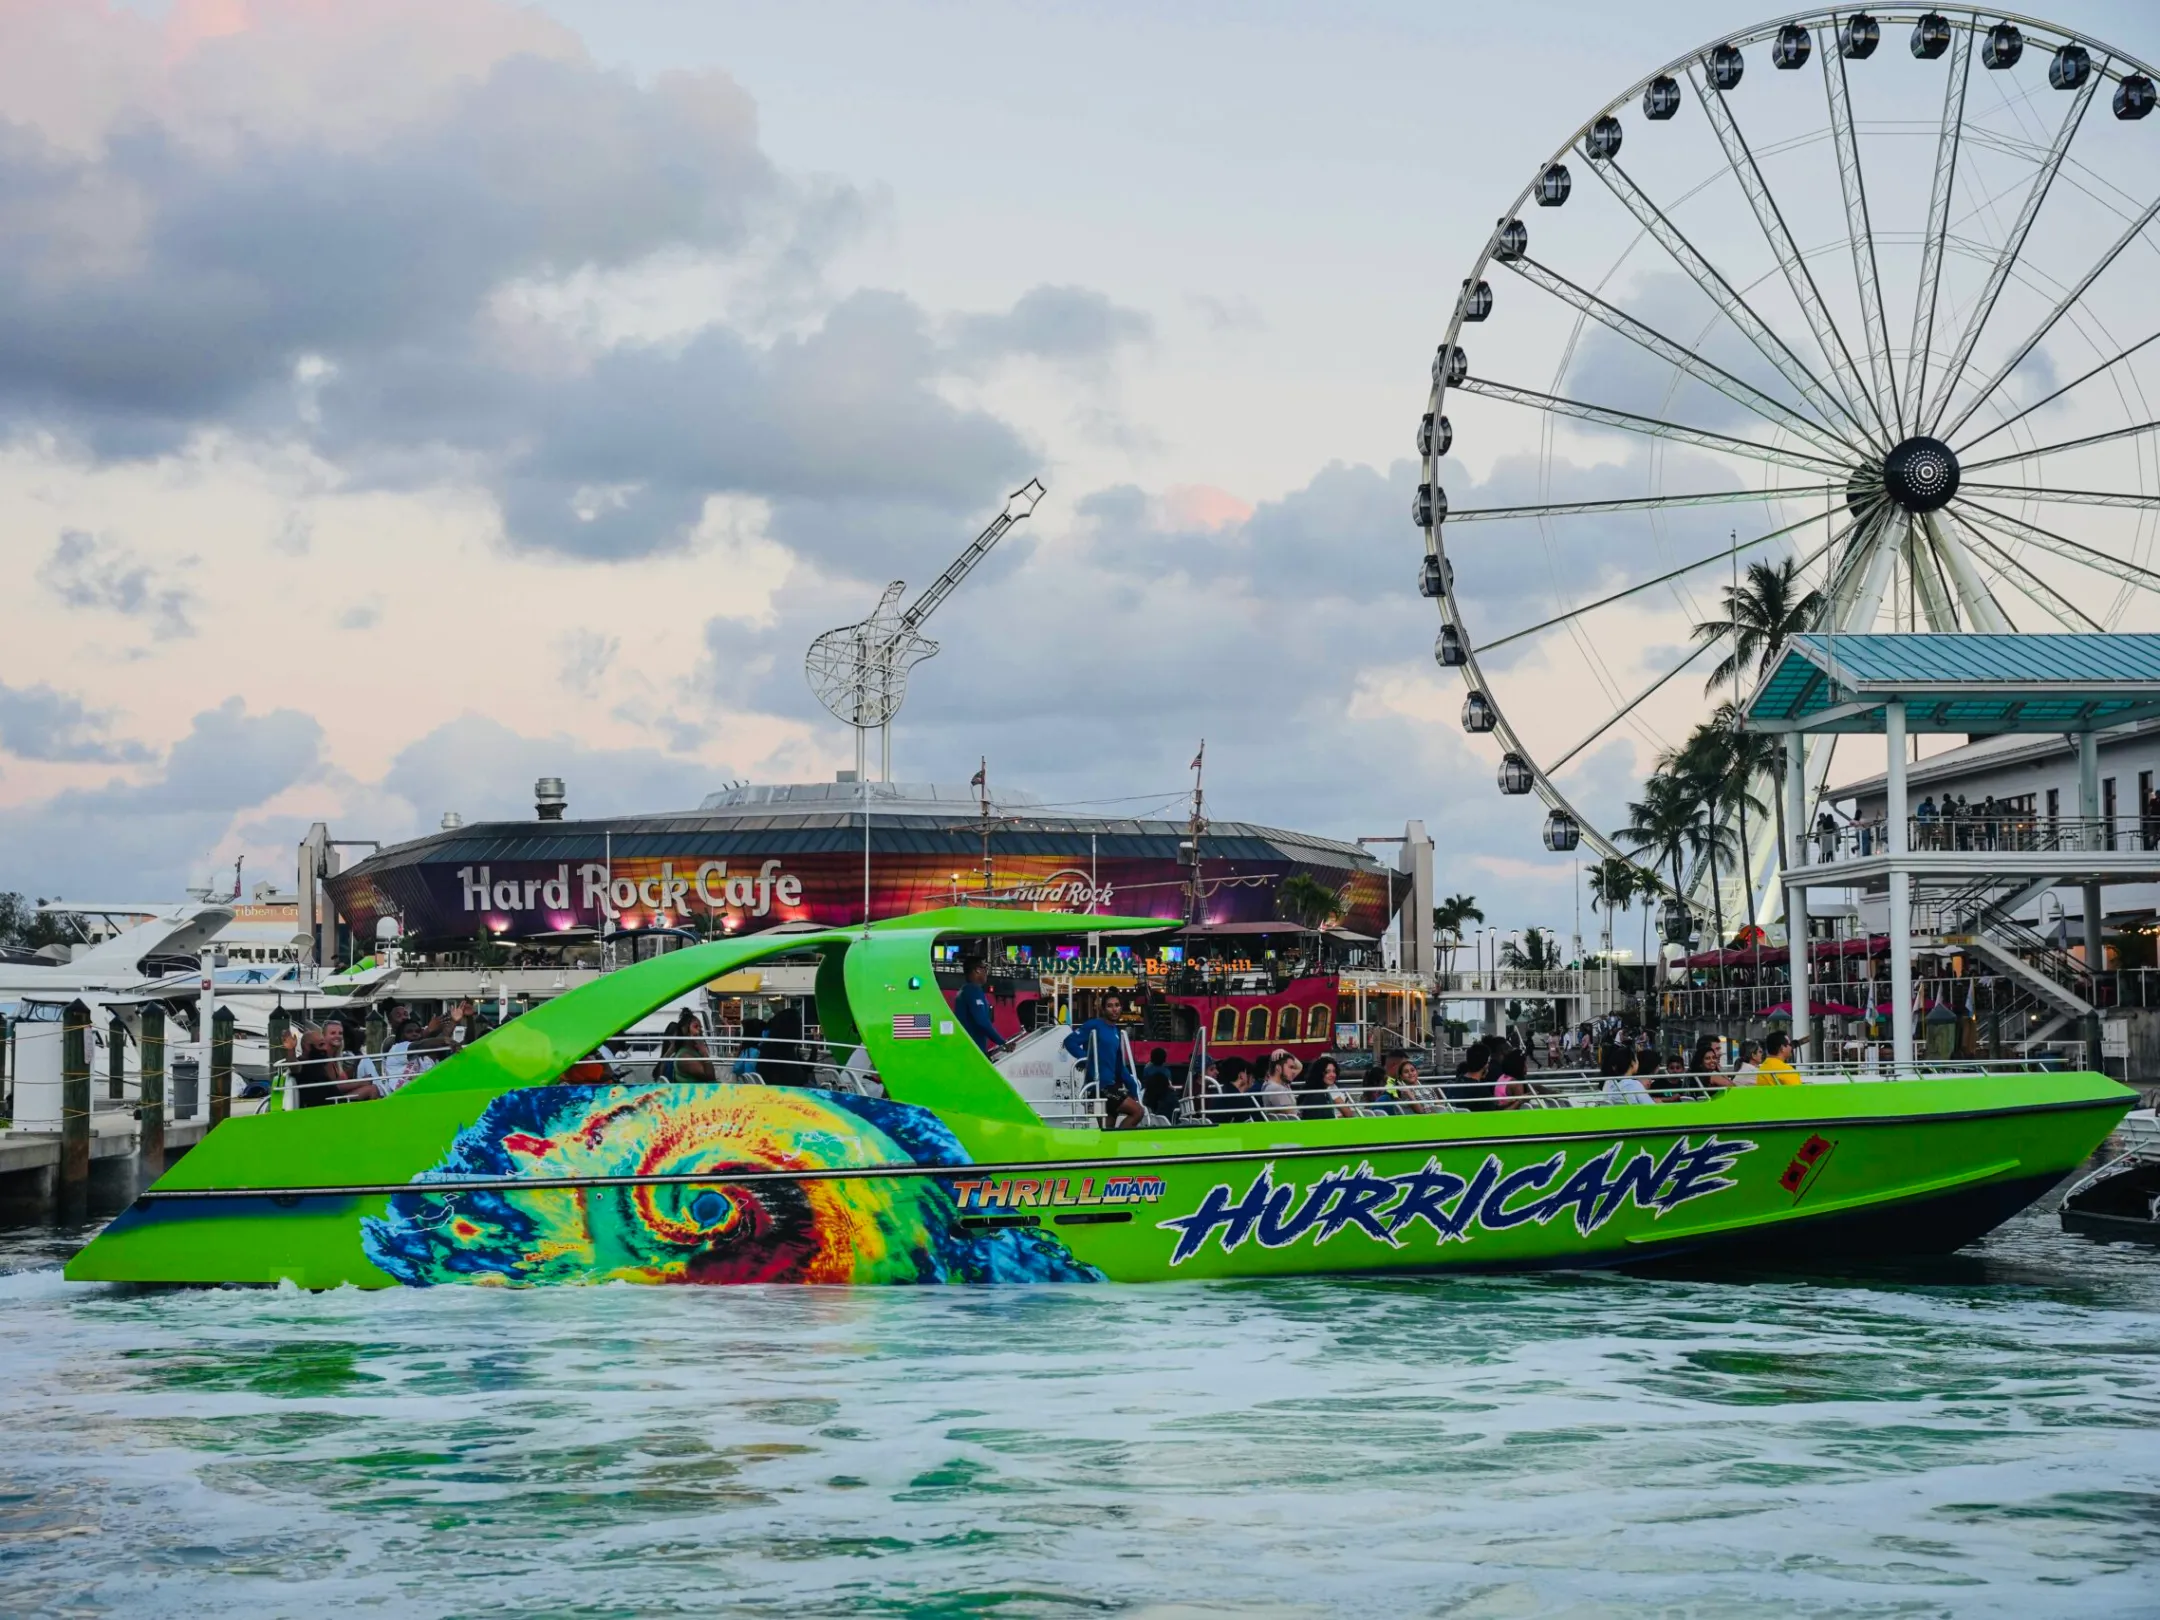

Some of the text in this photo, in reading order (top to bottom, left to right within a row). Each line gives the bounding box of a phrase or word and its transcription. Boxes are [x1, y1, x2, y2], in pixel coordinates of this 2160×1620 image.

[457, 860, 802, 919] Hard Rock Cafe
[1065, 881, 1114, 906] Rock
[235, 905, 277, 917] ribbean
[1145, 957, 1171, 975] Ba
[1103, 1180, 1166, 1198] MIAMI
[1156, 1134, 1760, 1268] HURRICANE
